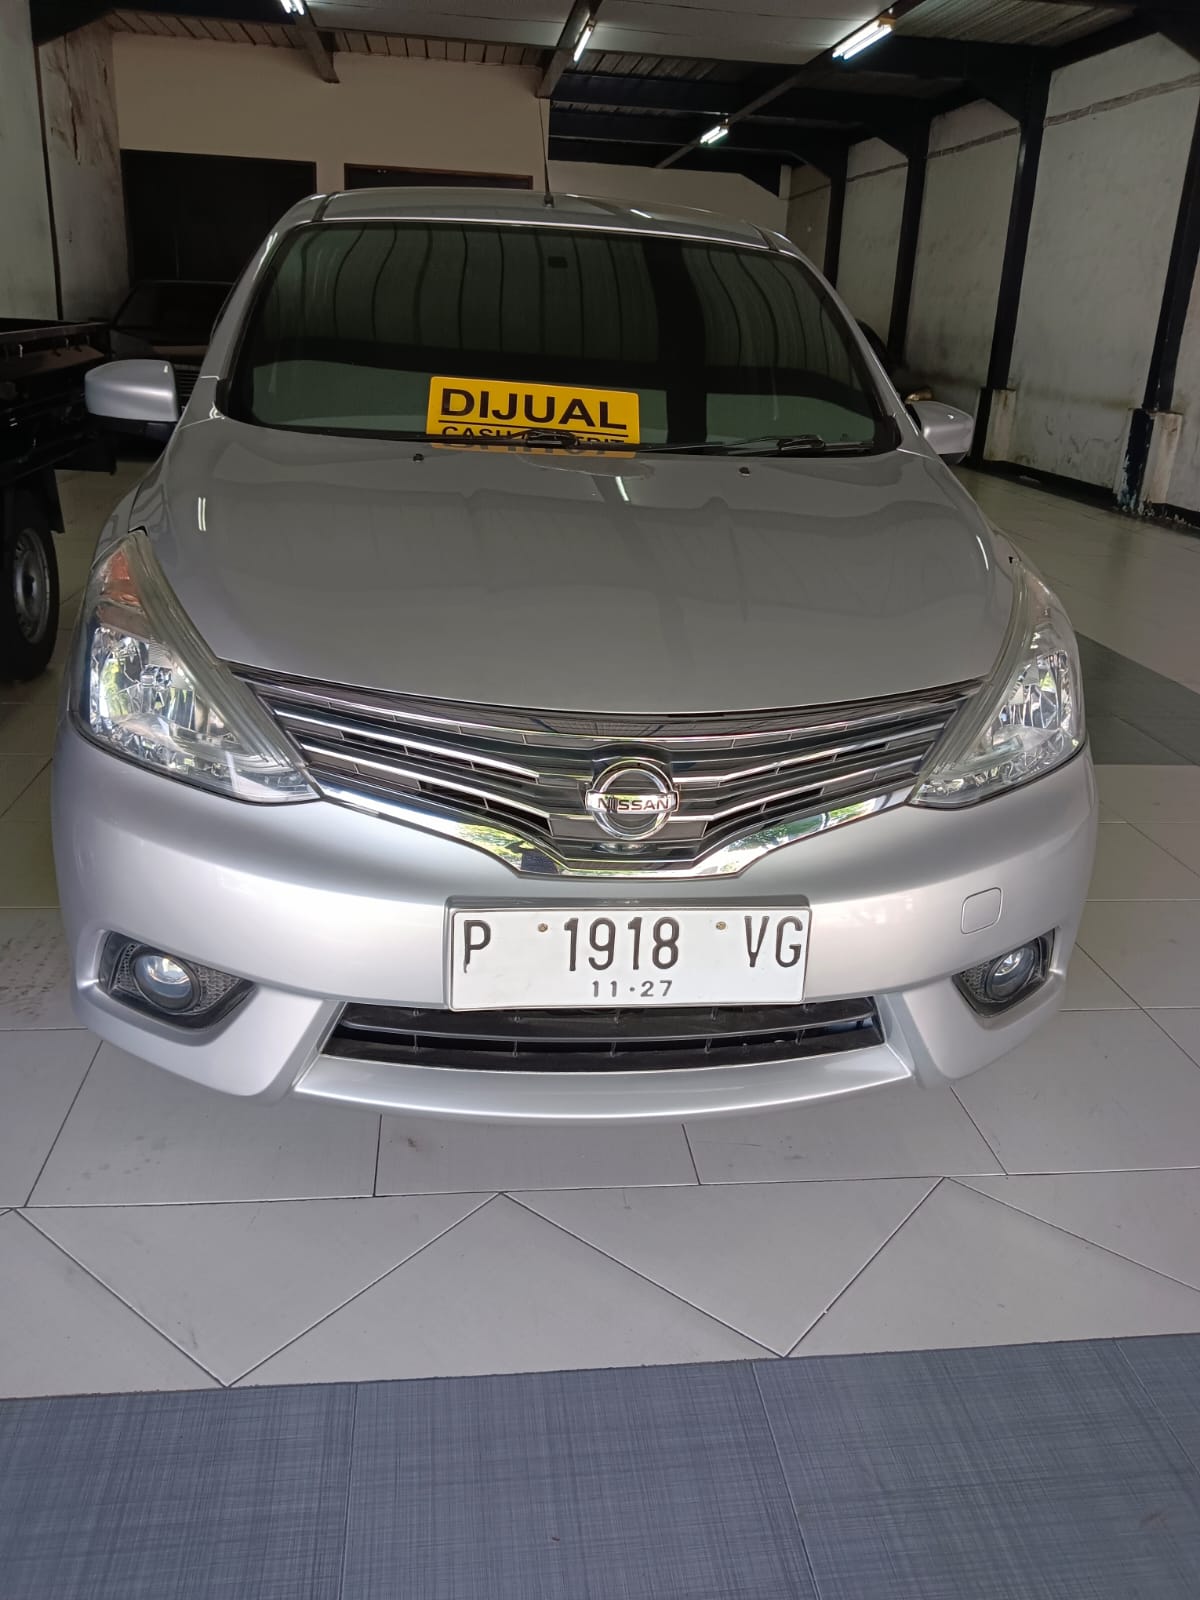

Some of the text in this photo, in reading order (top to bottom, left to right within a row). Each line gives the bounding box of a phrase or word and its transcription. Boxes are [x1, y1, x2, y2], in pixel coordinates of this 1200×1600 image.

[440, 387, 628, 431] DIJUAL
[598, 796, 670, 812] NISSAN
[463, 915, 804, 973] P 1918 VG
